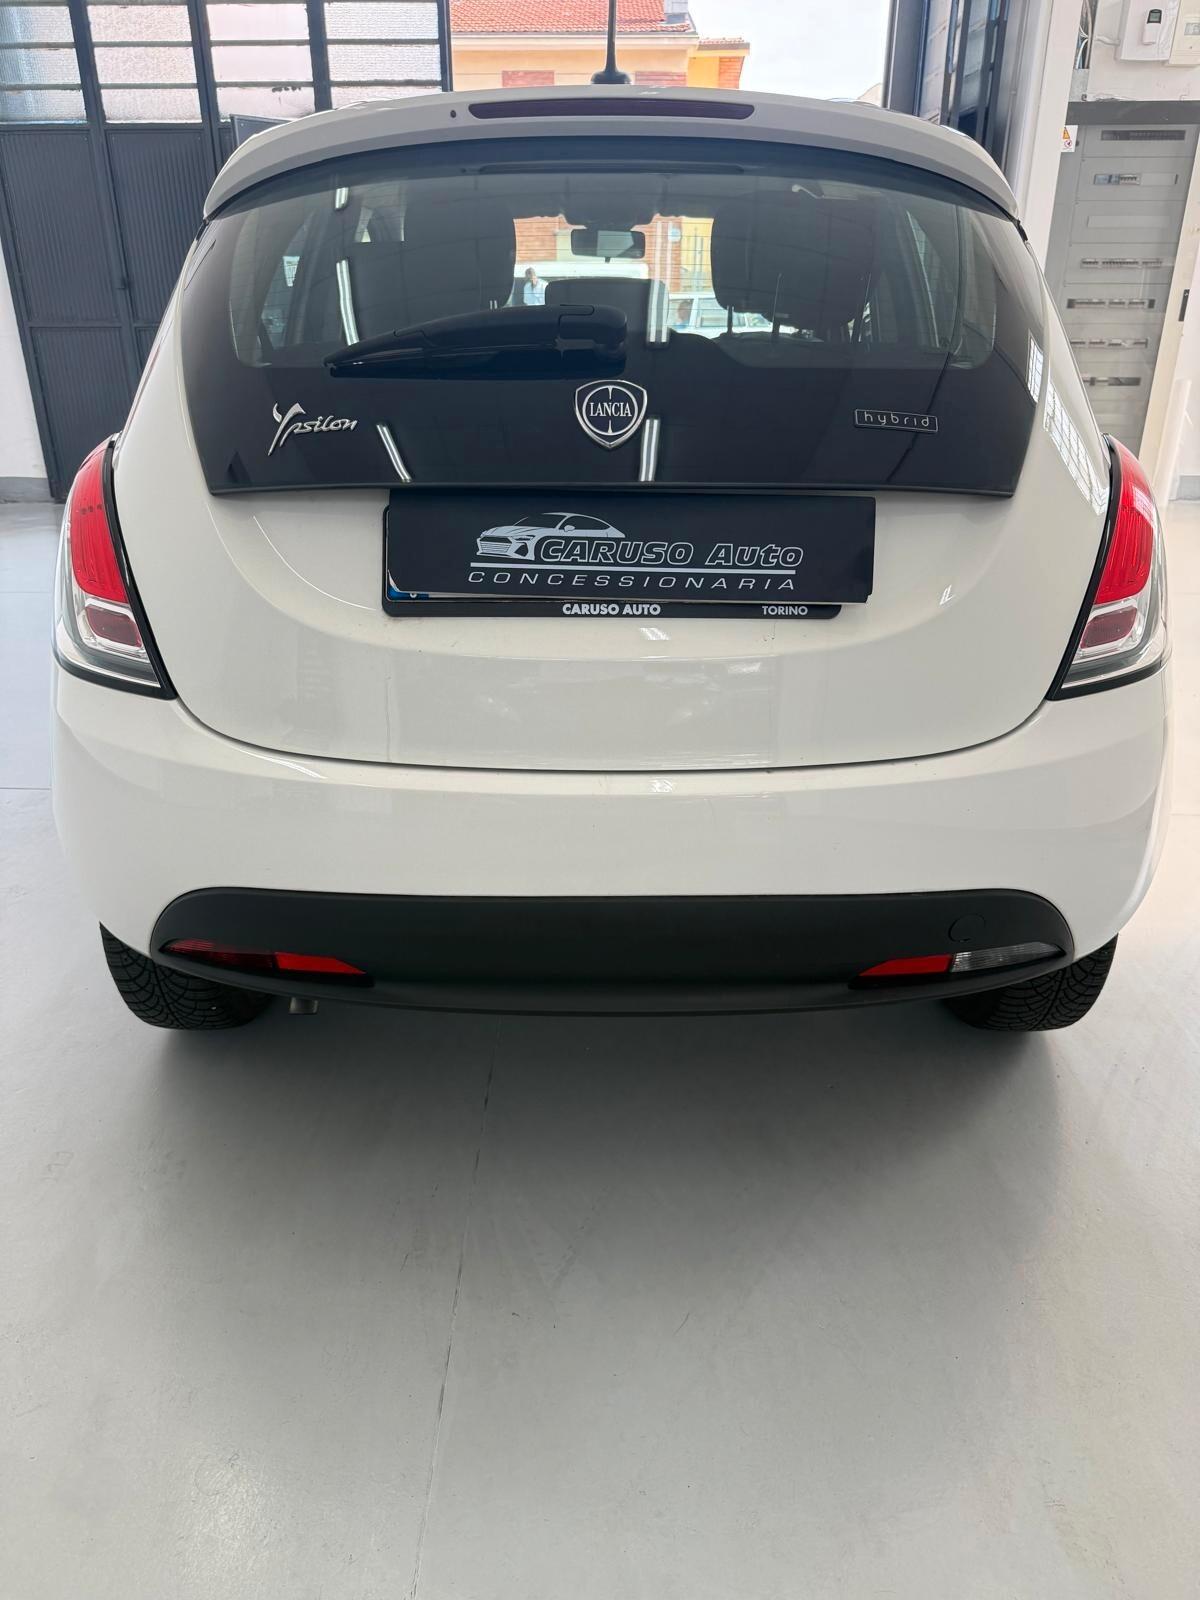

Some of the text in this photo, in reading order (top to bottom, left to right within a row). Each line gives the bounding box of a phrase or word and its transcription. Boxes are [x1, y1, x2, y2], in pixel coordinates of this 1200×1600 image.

[589, 402, 632, 417] LANCIA
[864, 411, 929, 427] hybrid
[268, 402, 358, 456] Ypsilon
[540, 539, 804, 567] CARUSO Auto
[467, 571, 795, 590] CONCESSIONARIA
[562, 603, 661, 616] CARUSO AUTO
[761, 605, 808, 616] TORINO
